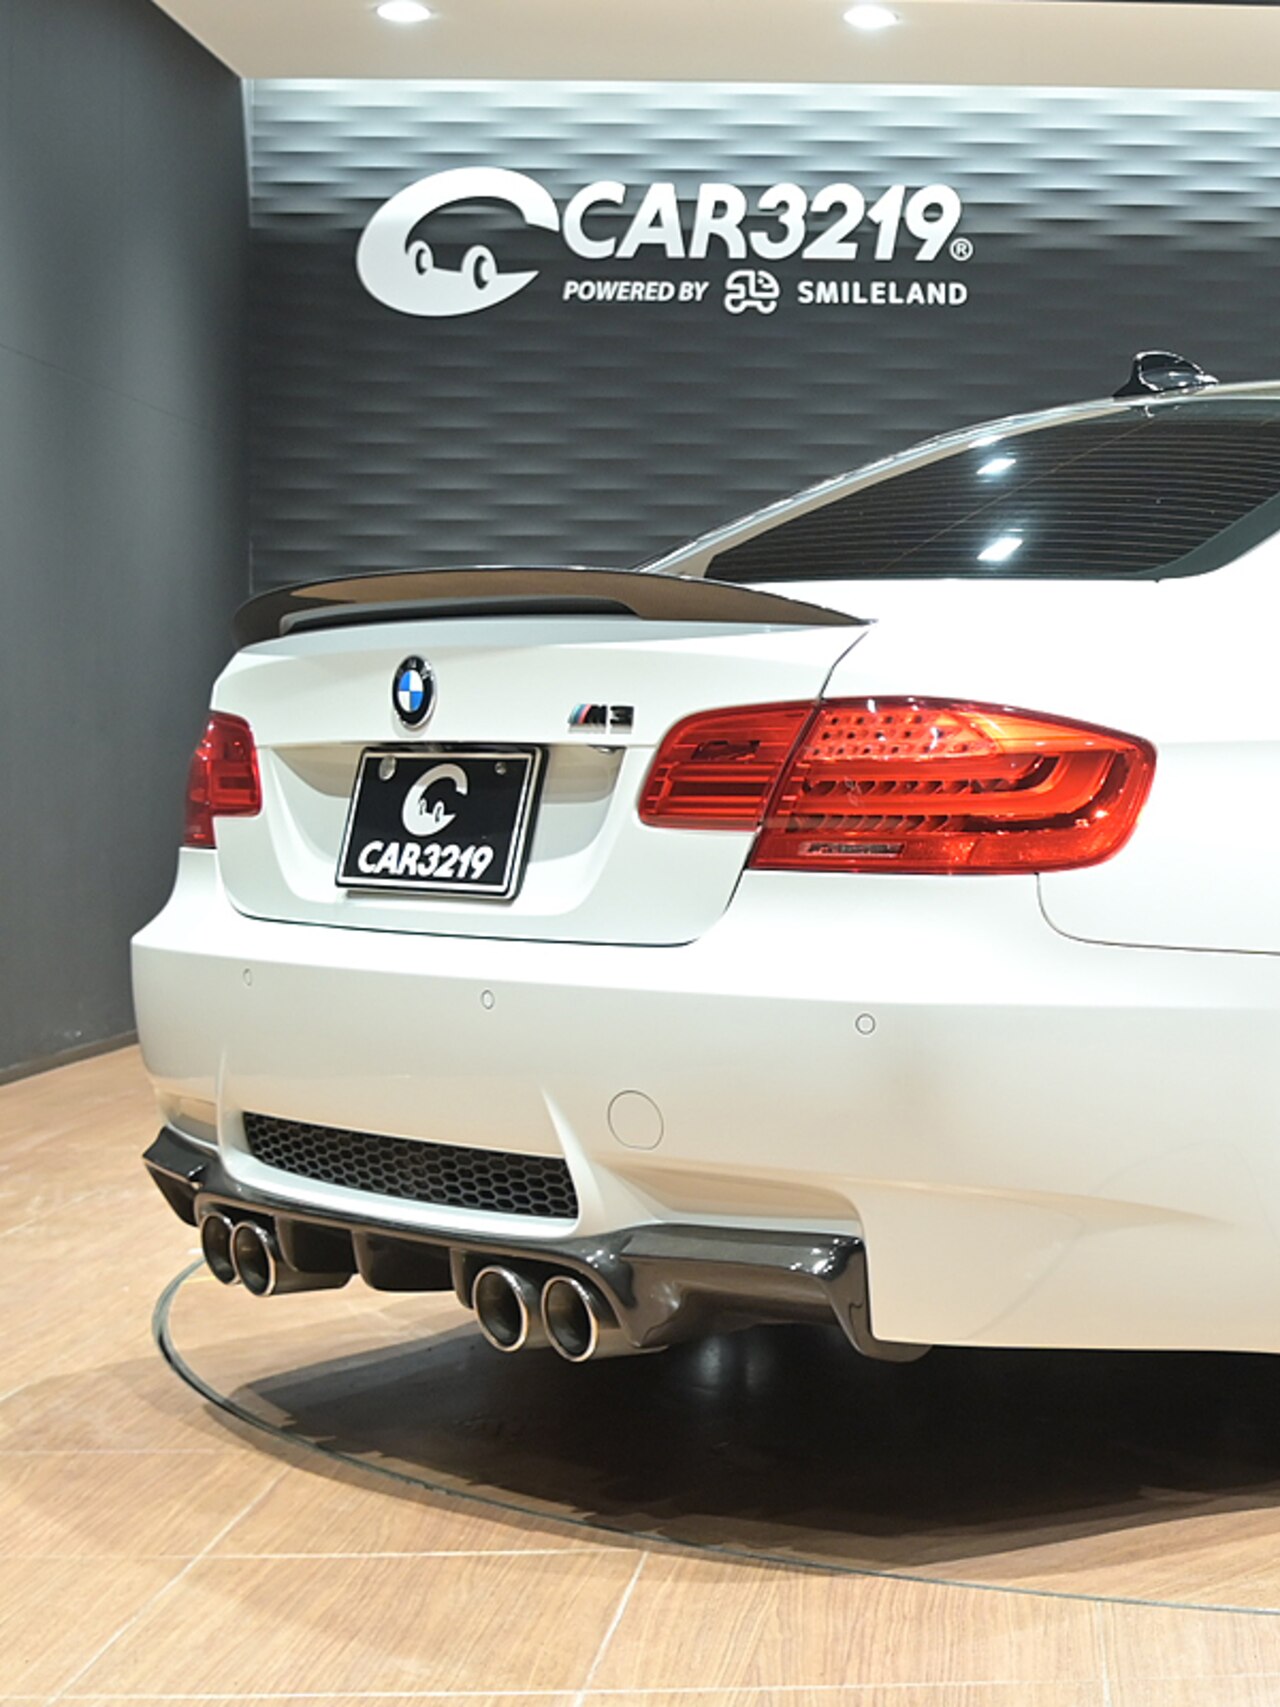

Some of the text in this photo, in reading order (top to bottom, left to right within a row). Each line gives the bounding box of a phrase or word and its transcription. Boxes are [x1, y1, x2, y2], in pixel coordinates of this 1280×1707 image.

[563, 280, 968, 305] POWERED BY SMILELAND
[357, 841, 494, 880] CAR3219
